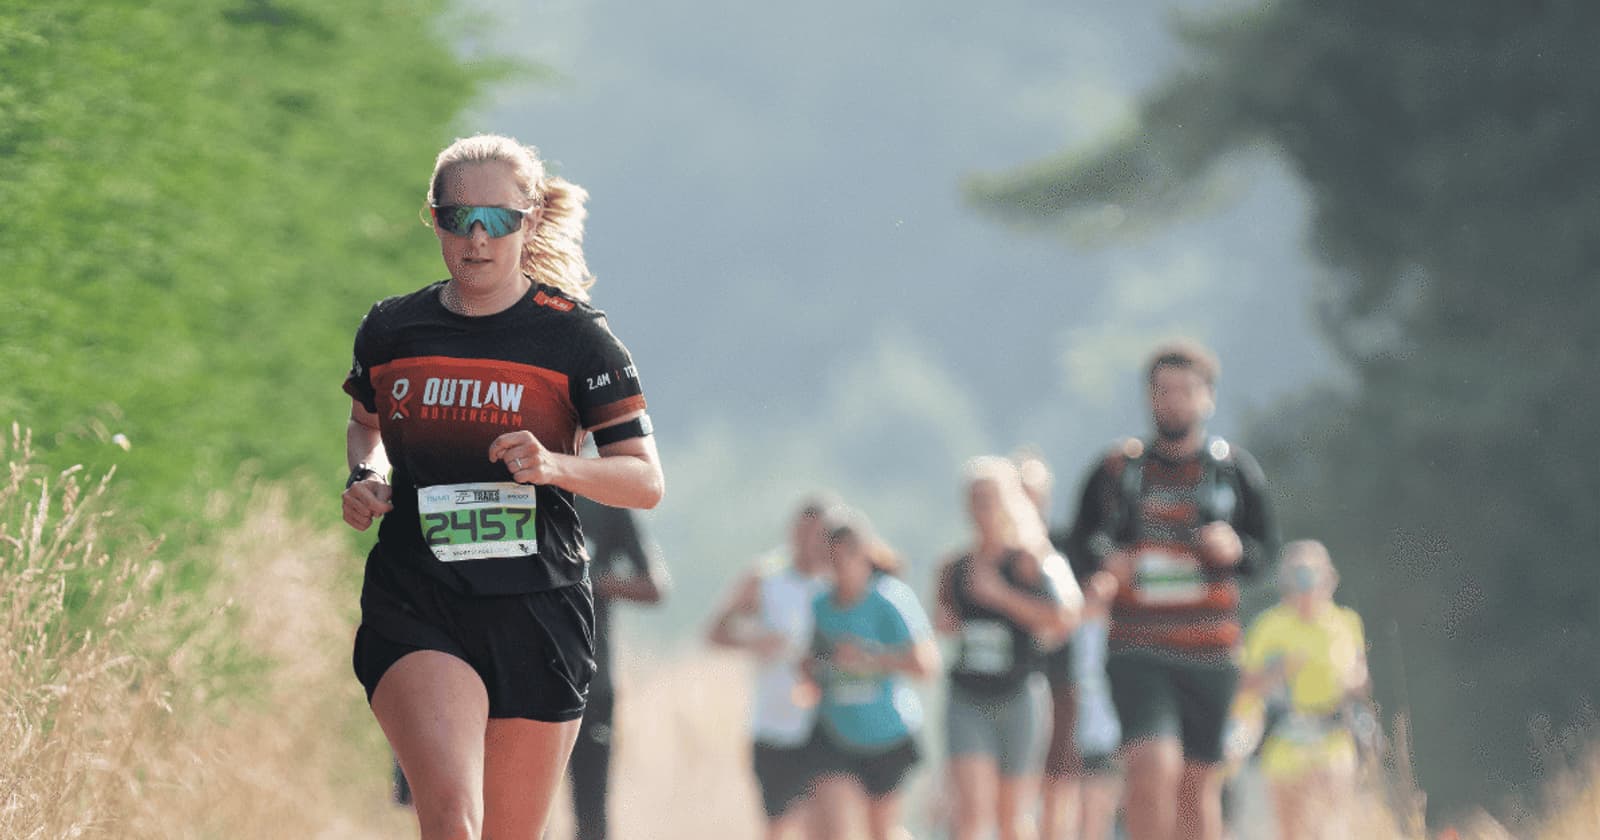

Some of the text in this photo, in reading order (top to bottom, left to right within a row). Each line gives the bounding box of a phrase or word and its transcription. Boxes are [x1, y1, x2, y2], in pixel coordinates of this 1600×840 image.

[422, 377, 525, 413] OUTLAW
[586, 372, 611, 390] 2.4M
[420, 406, 523, 427] NOTTINGHAM
[424, 508, 532, 545] 2457
